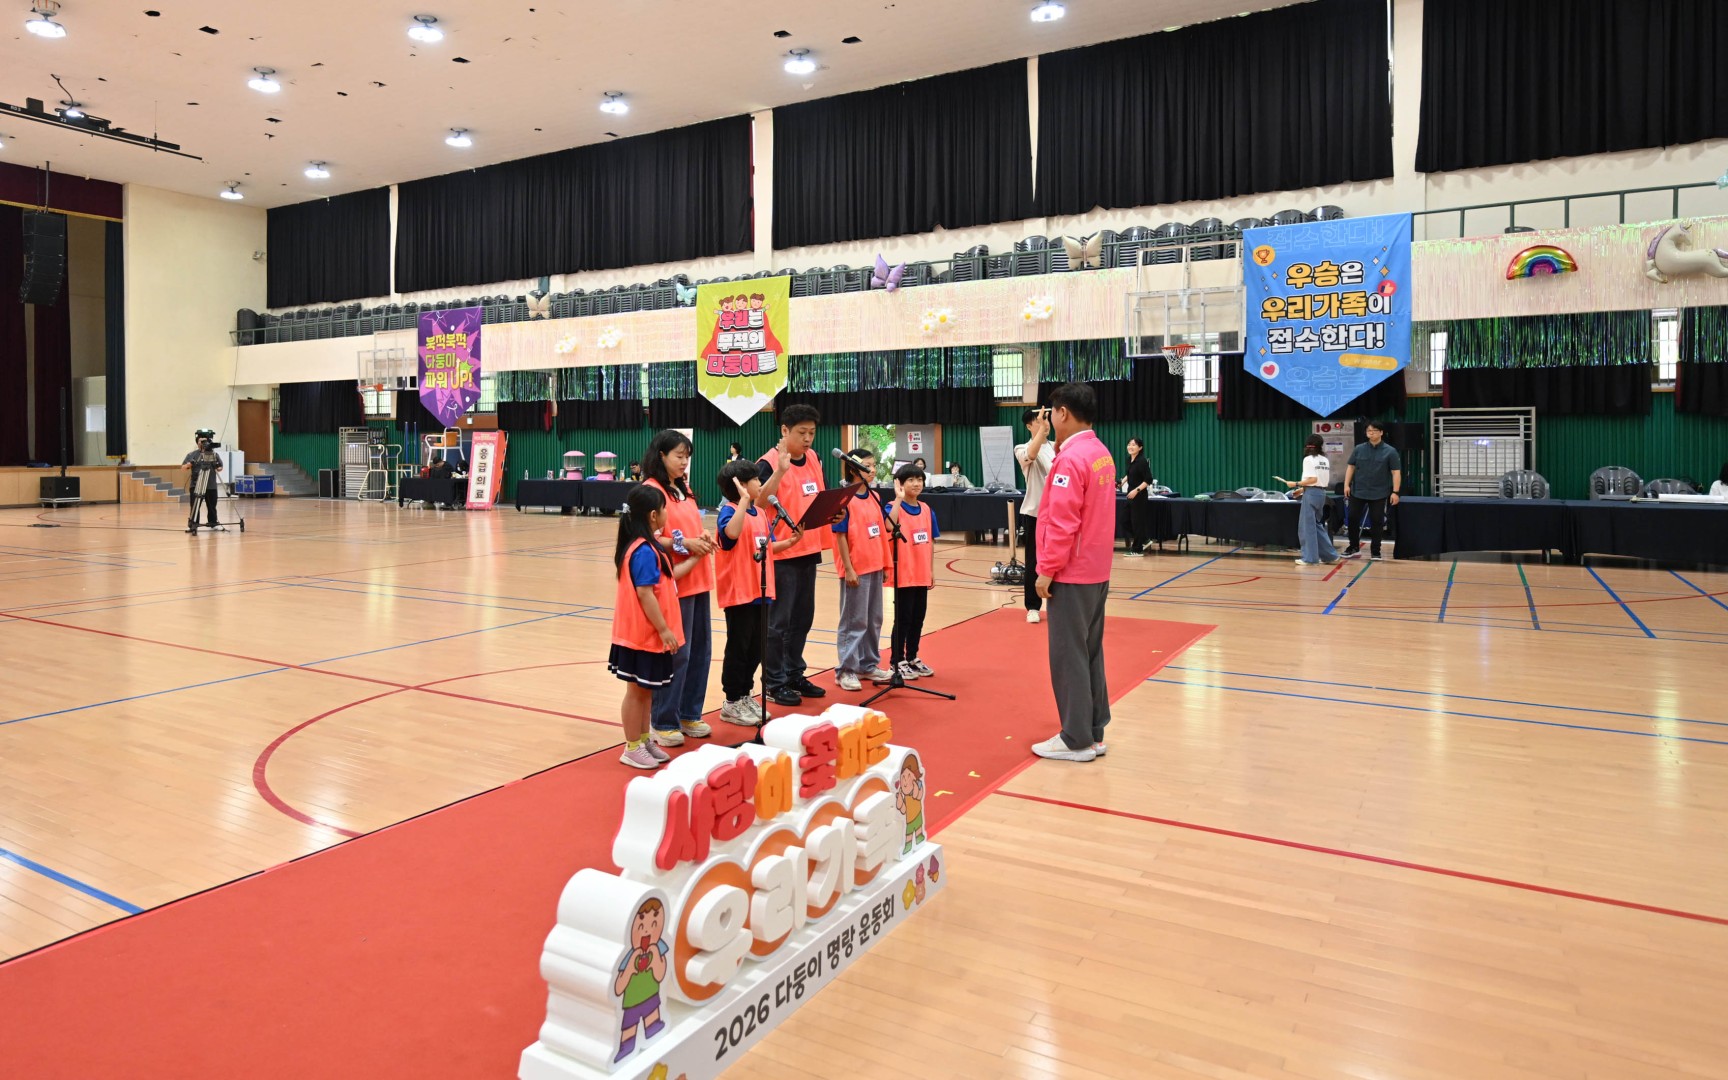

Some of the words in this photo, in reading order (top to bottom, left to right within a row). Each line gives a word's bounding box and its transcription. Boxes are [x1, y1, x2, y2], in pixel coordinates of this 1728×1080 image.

[1285, 261, 1364, 289] 우승은
[719, 310, 764, 329] 우리는
[1260, 291, 1392, 322] 우리가족이
[425, 333, 467, 351] 북적북적
[1267, 322, 1385, 354] 접수한다!
[424, 371, 448, 389] 파워
[450, 360, 474, 390] UP!
[425, 352, 456, 369] 다둥이
[475, 448, 488, 499] 응급의료
[655, 752, 793, 871] 사랑이
[799, 712, 893, 799] 꽃피는
[685, 791, 898, 987] 우리가족
[714, 993, 770, 1061] 2026
[775, 951, 822, 1008] 다둥이
[827, 924, 856, 970] 명랑
[858, 894, 895, 946] 운동회
